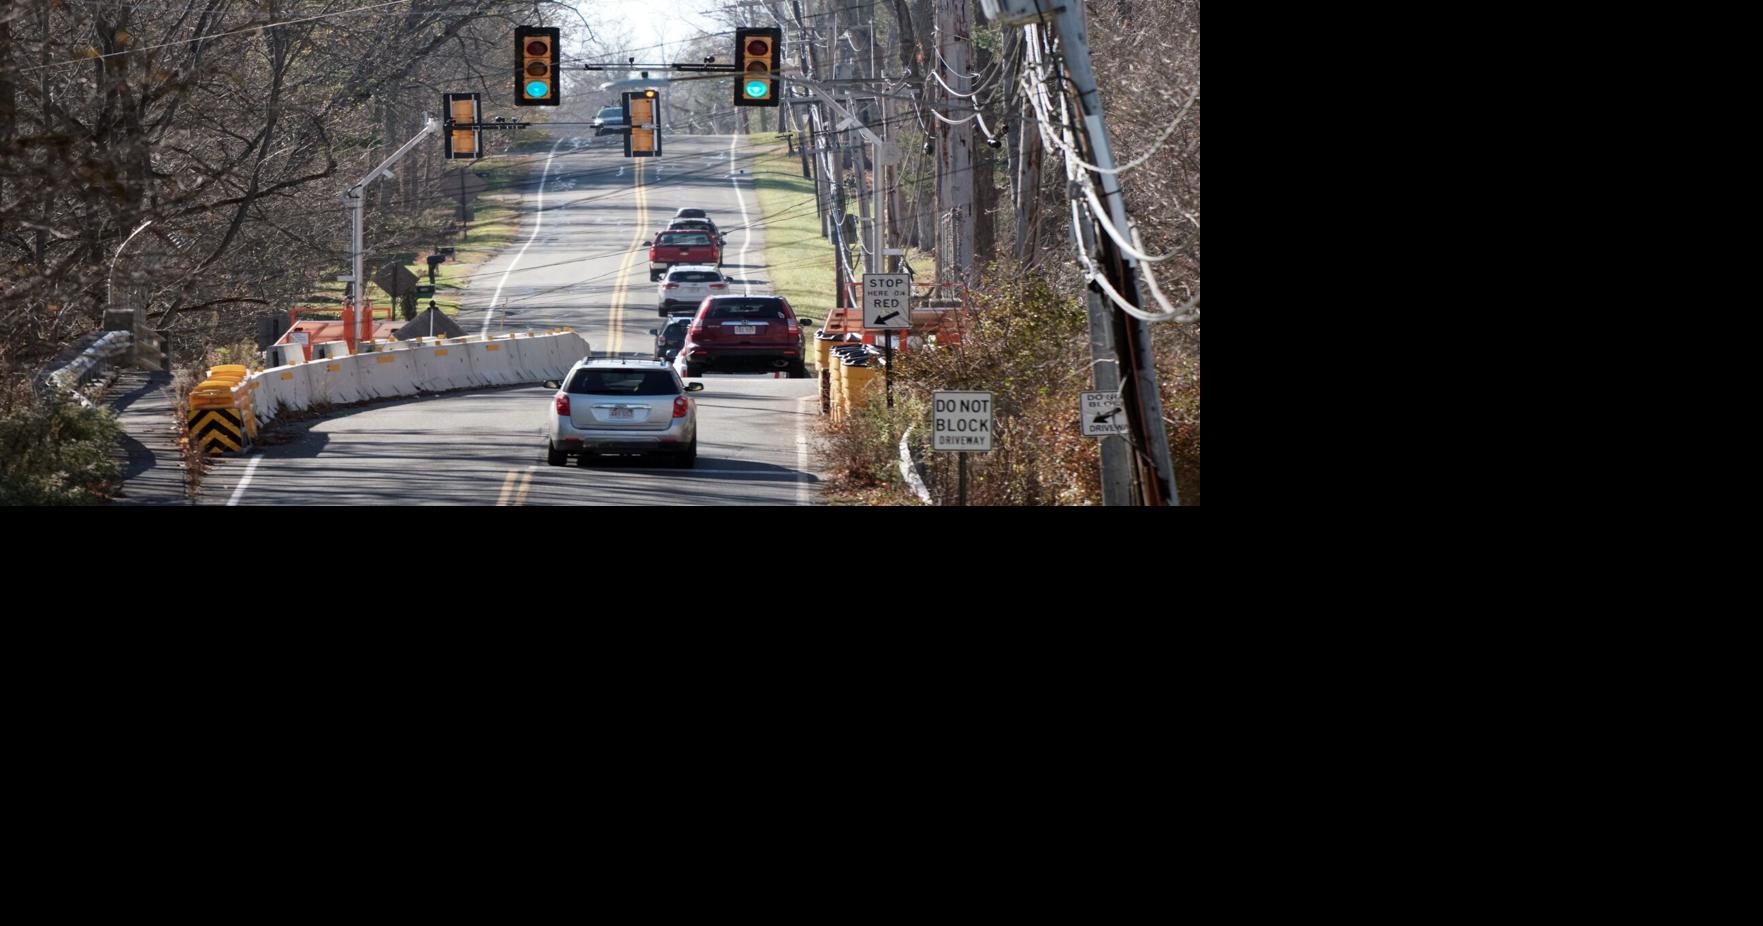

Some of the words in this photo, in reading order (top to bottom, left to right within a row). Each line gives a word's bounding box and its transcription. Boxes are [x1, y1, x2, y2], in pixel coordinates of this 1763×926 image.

[870, 279, 903, 288] STOP
[874, 299, 899, 308] RED
[936, 400, 956, 413] DO
[960, 400, 989, 413] NOT
[936, 419, 989, 432] BLOCK
[939, 436, 985, 445] DRIVEWAY
